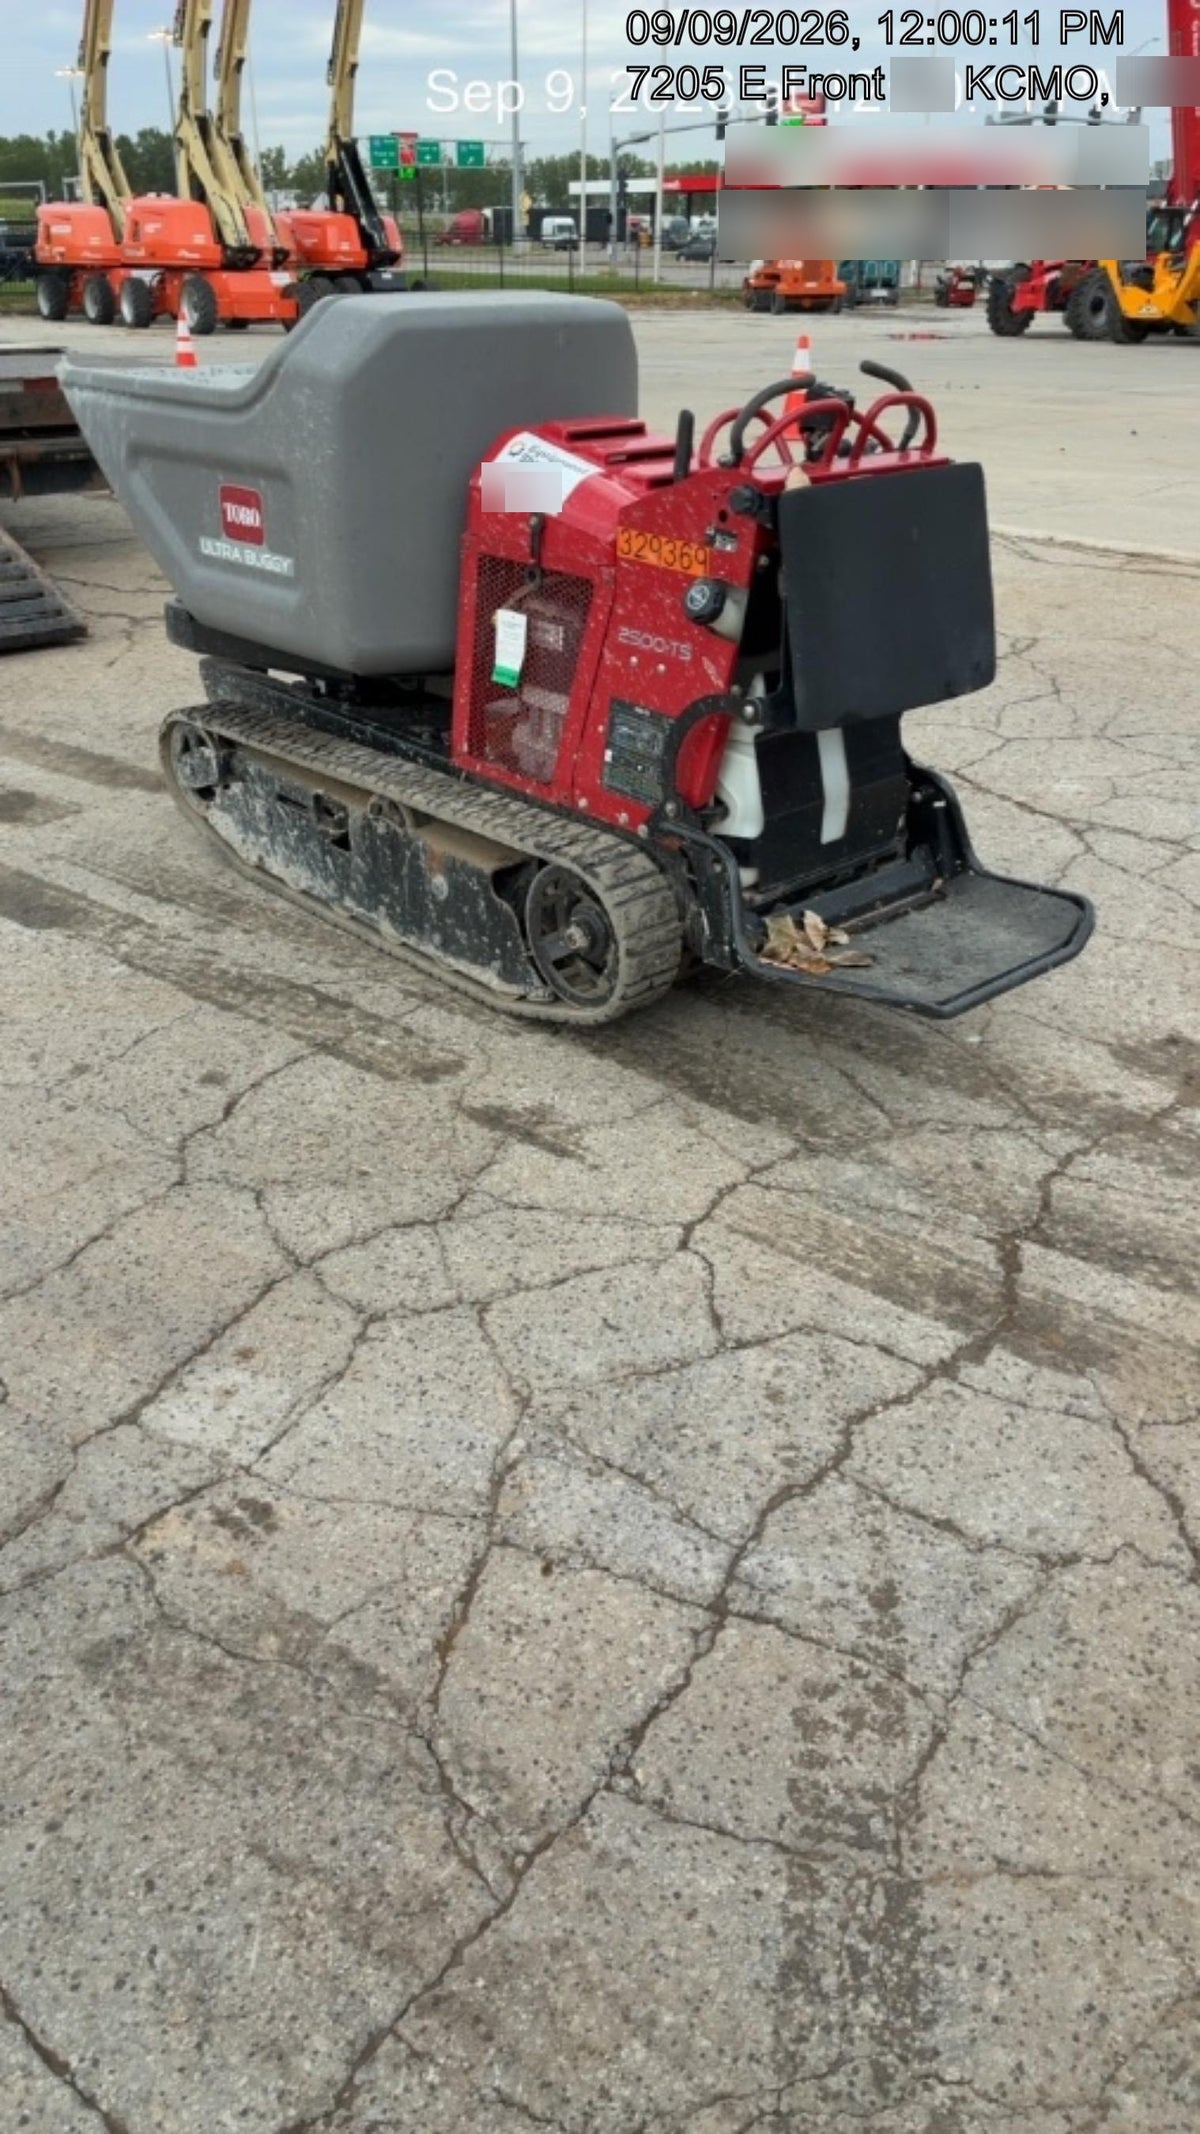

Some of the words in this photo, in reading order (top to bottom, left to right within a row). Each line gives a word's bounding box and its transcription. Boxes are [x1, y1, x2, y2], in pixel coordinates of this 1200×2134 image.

[222, 502, 260, 528] TORO
[200, 537, 242, 562] ULTRA
[244, 549, 291, 574] BUGGY
[619, 528, 708, 576] 329369
